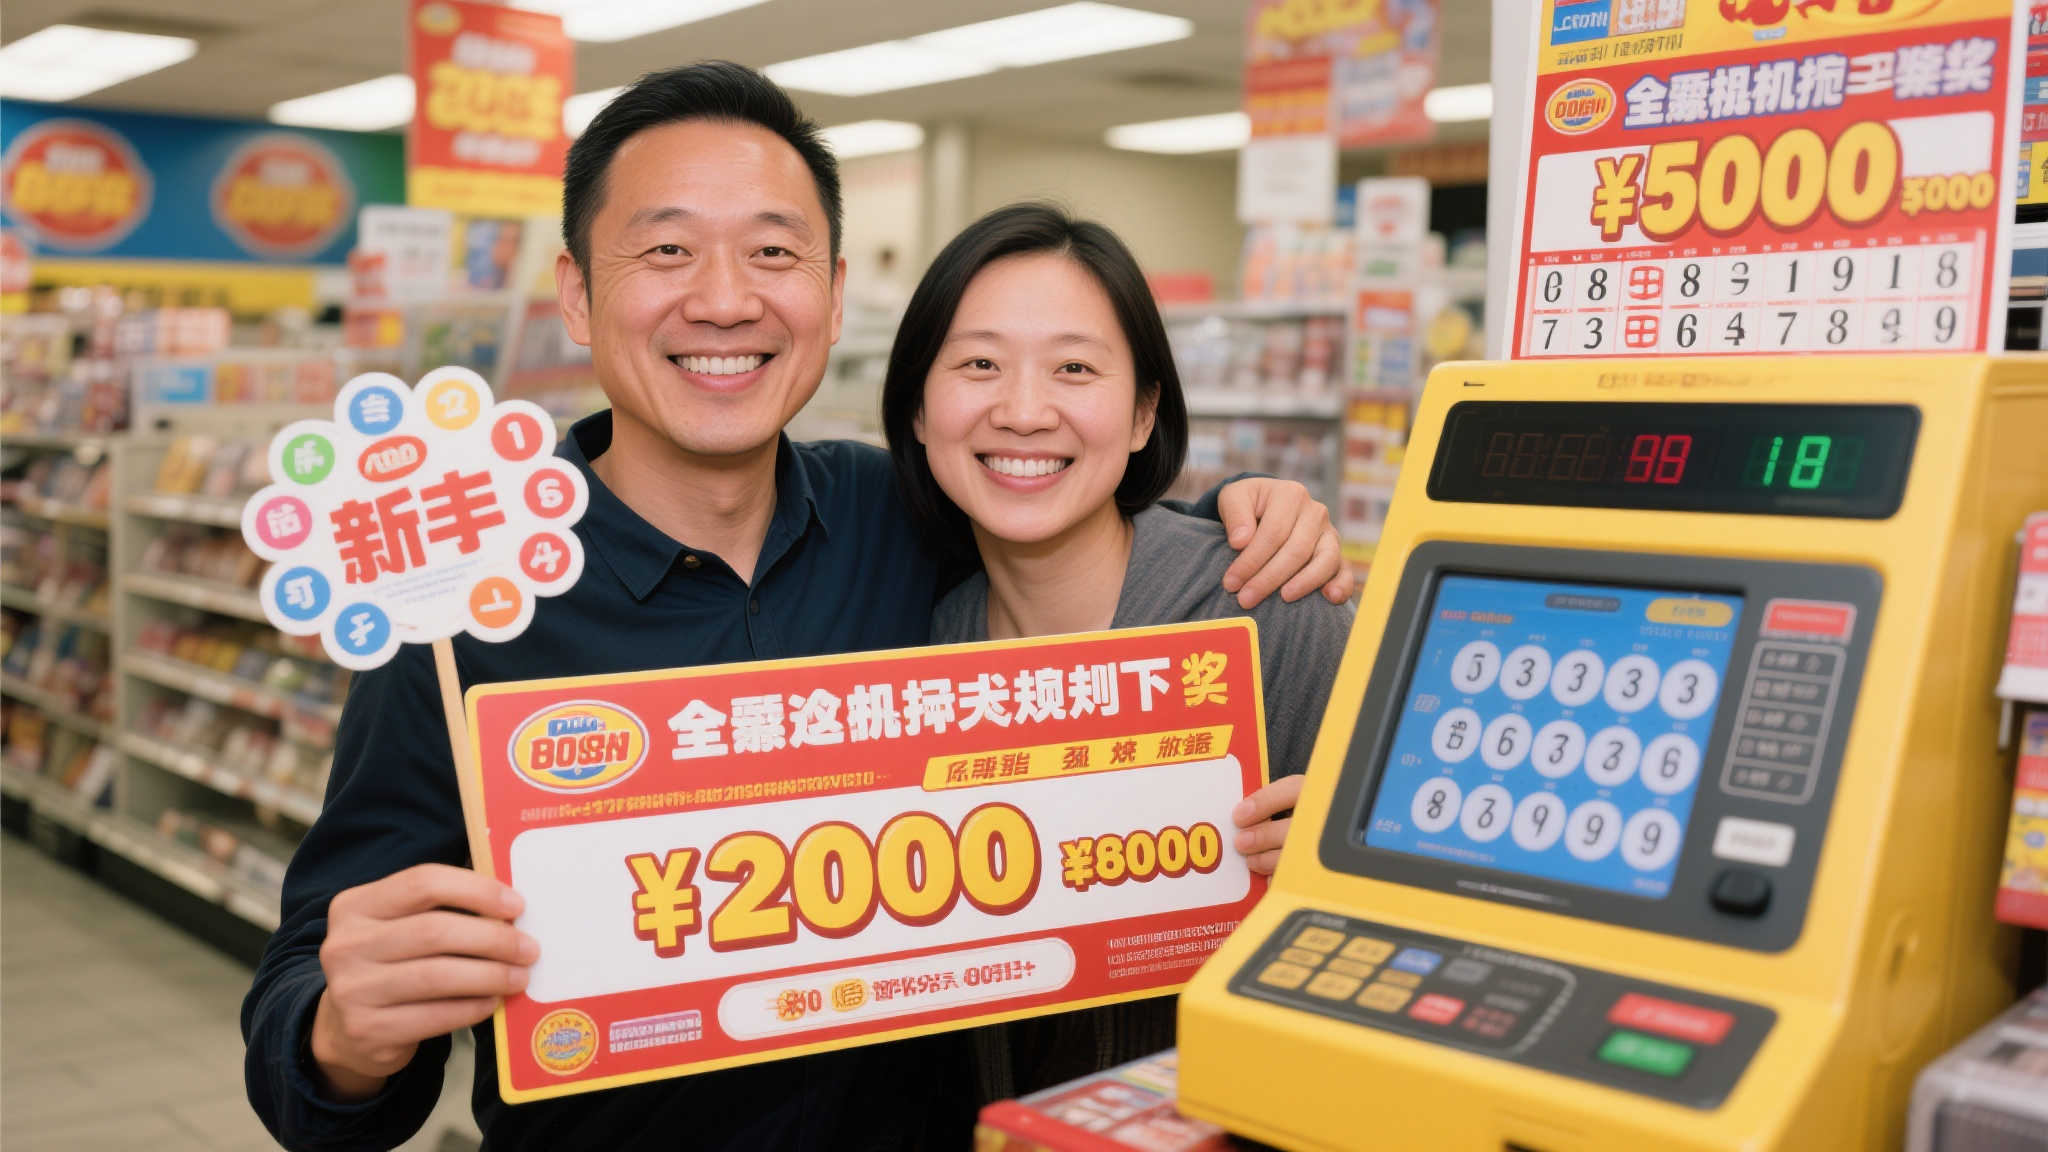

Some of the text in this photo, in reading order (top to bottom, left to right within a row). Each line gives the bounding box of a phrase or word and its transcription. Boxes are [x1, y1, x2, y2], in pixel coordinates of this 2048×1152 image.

[1591, 121, 1903, 243] ¥5000
[1587, 268, 1607, 300] 8
[1680, 263, 1700, 297] 8
[1788, 259, 1798, 293] 1
[1833, 256, 1853, 292] 9
[1936, 250, 1958, 289] 8
[1542, 319, 1558, 350] 7
[1584, 317, 1603, 350] 3
[1677, 313, 1697, 348] 6
[1777, 312, 1797, 345] 7
[1826, 309, 1848, 345] 8
[1935, 306, 1956, 343] 9
[507, 421, 526, 450] 1
[1763, 435, 1831, 488] 18
[1515, 658, 1535, 687] 3
[1568, 663, 1588, 692] 3
[1622, 668, 1642, 699] 3
[1677, 673, 1698, 704] 3
[1498, 727, 1517, 756] 6
[1427, 789, 1446, 819] 8
[1532, 804, 1549, 837] 9
[1583, 815, 1604, 846] 9
[1641, 821, 1660, 856] 9
[625, 802, 1041, 958] ¥2000
[1059, 822, 1223, 892] ¥8000
